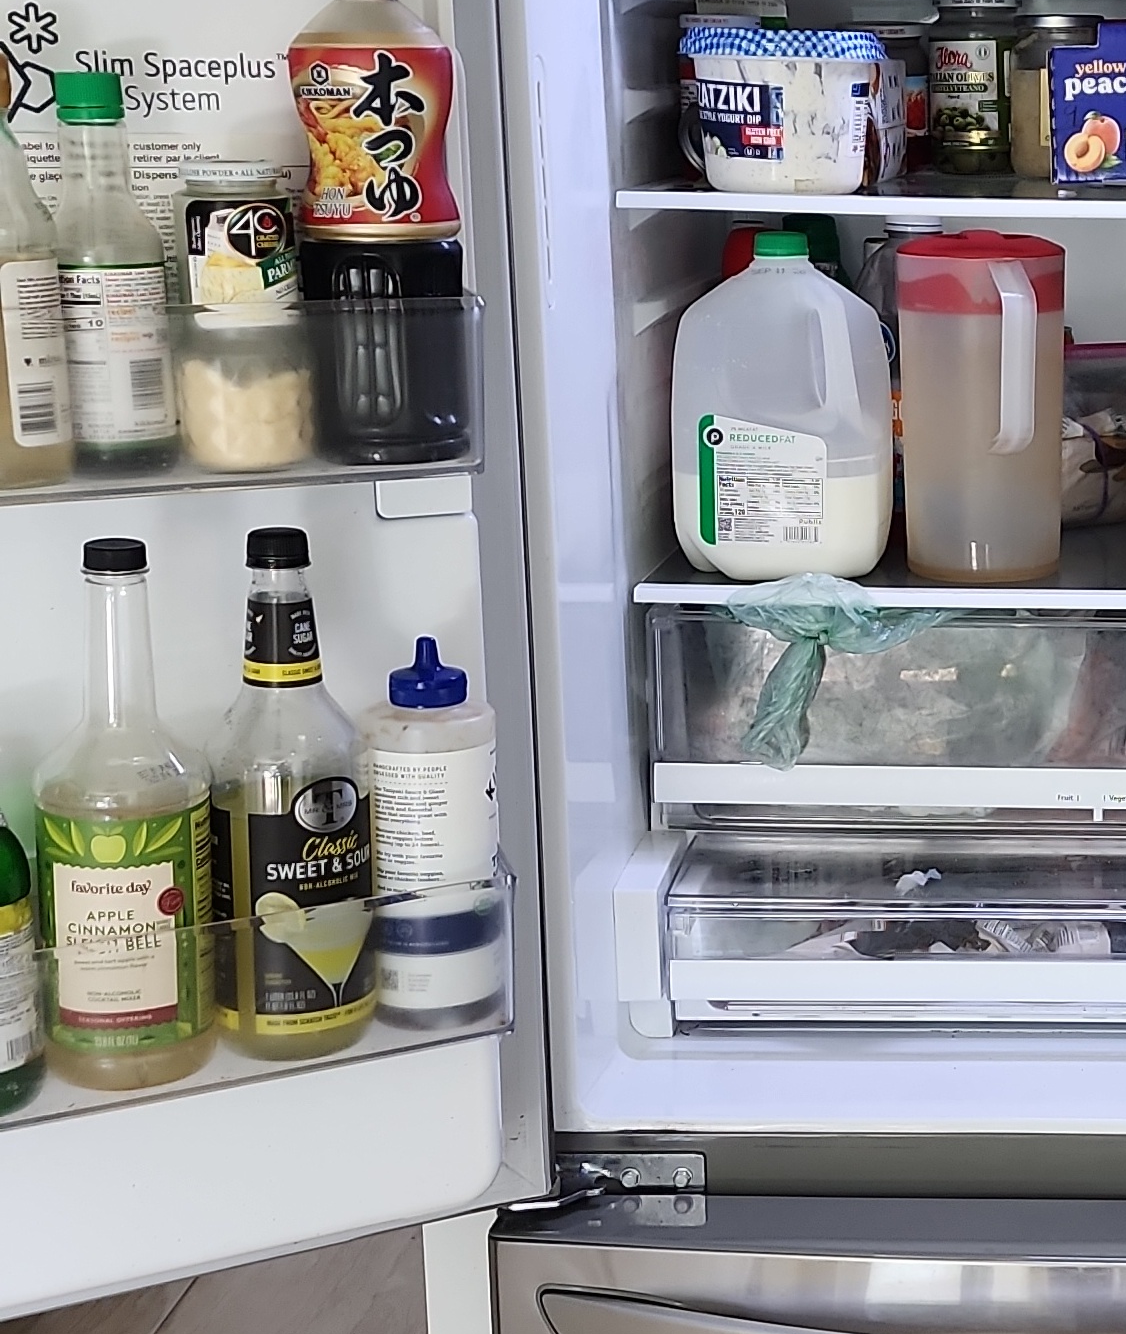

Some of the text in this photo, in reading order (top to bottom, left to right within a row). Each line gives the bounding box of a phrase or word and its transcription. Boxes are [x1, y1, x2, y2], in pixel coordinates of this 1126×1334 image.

[75, 50, 134, 78] Slim
[300, 87, 351, 97] KIKKOMAN
[124, 84, 221, 118] System
[717, 112, 763, 125] YOGURT DIP
[351, 50, 426, 220] 本つゆ
[132, 142, 179, 152] customer
[181, 142, 202, 154] only
[26, 153, 61, 165] iquette
[132, 153, 163, 163] retirer
[165, 155, 181, 165] par
[132, 170, 179, 181] Dispens
[202, 169, 234, 177] POWDER
[131, 184, 150, 192] tion
[321, 187, 345, 200] HON
[314, 202, 352, 217] TSUYU
[228, 208, 280, 257] 4C
[266, 261, 296, 284] PARM
[76, 274, 101, 285] Facts
[87, 319, 104, 328] 10
[294, 620, 312, 634] CANE
[292, 630, 314, 645] SUGAR
[423, 765, 448, 773] PEOPLE
[417, 772, 445, 780] QUALITY
[1057, 794, 1074, 802] Fruit
[302, 829, 359, 862] Classic
[266, 859, 329, 881] SWEET
[331, 856, 344, 874] &
[345, 842, 371, 870] SOUR
[70, 879, 153, 896] favorite day
[86, 909, 136, 922] APPLE
[67, 920, 157, 937] CINNAMON
[125, 933, 163, 952] BELL
